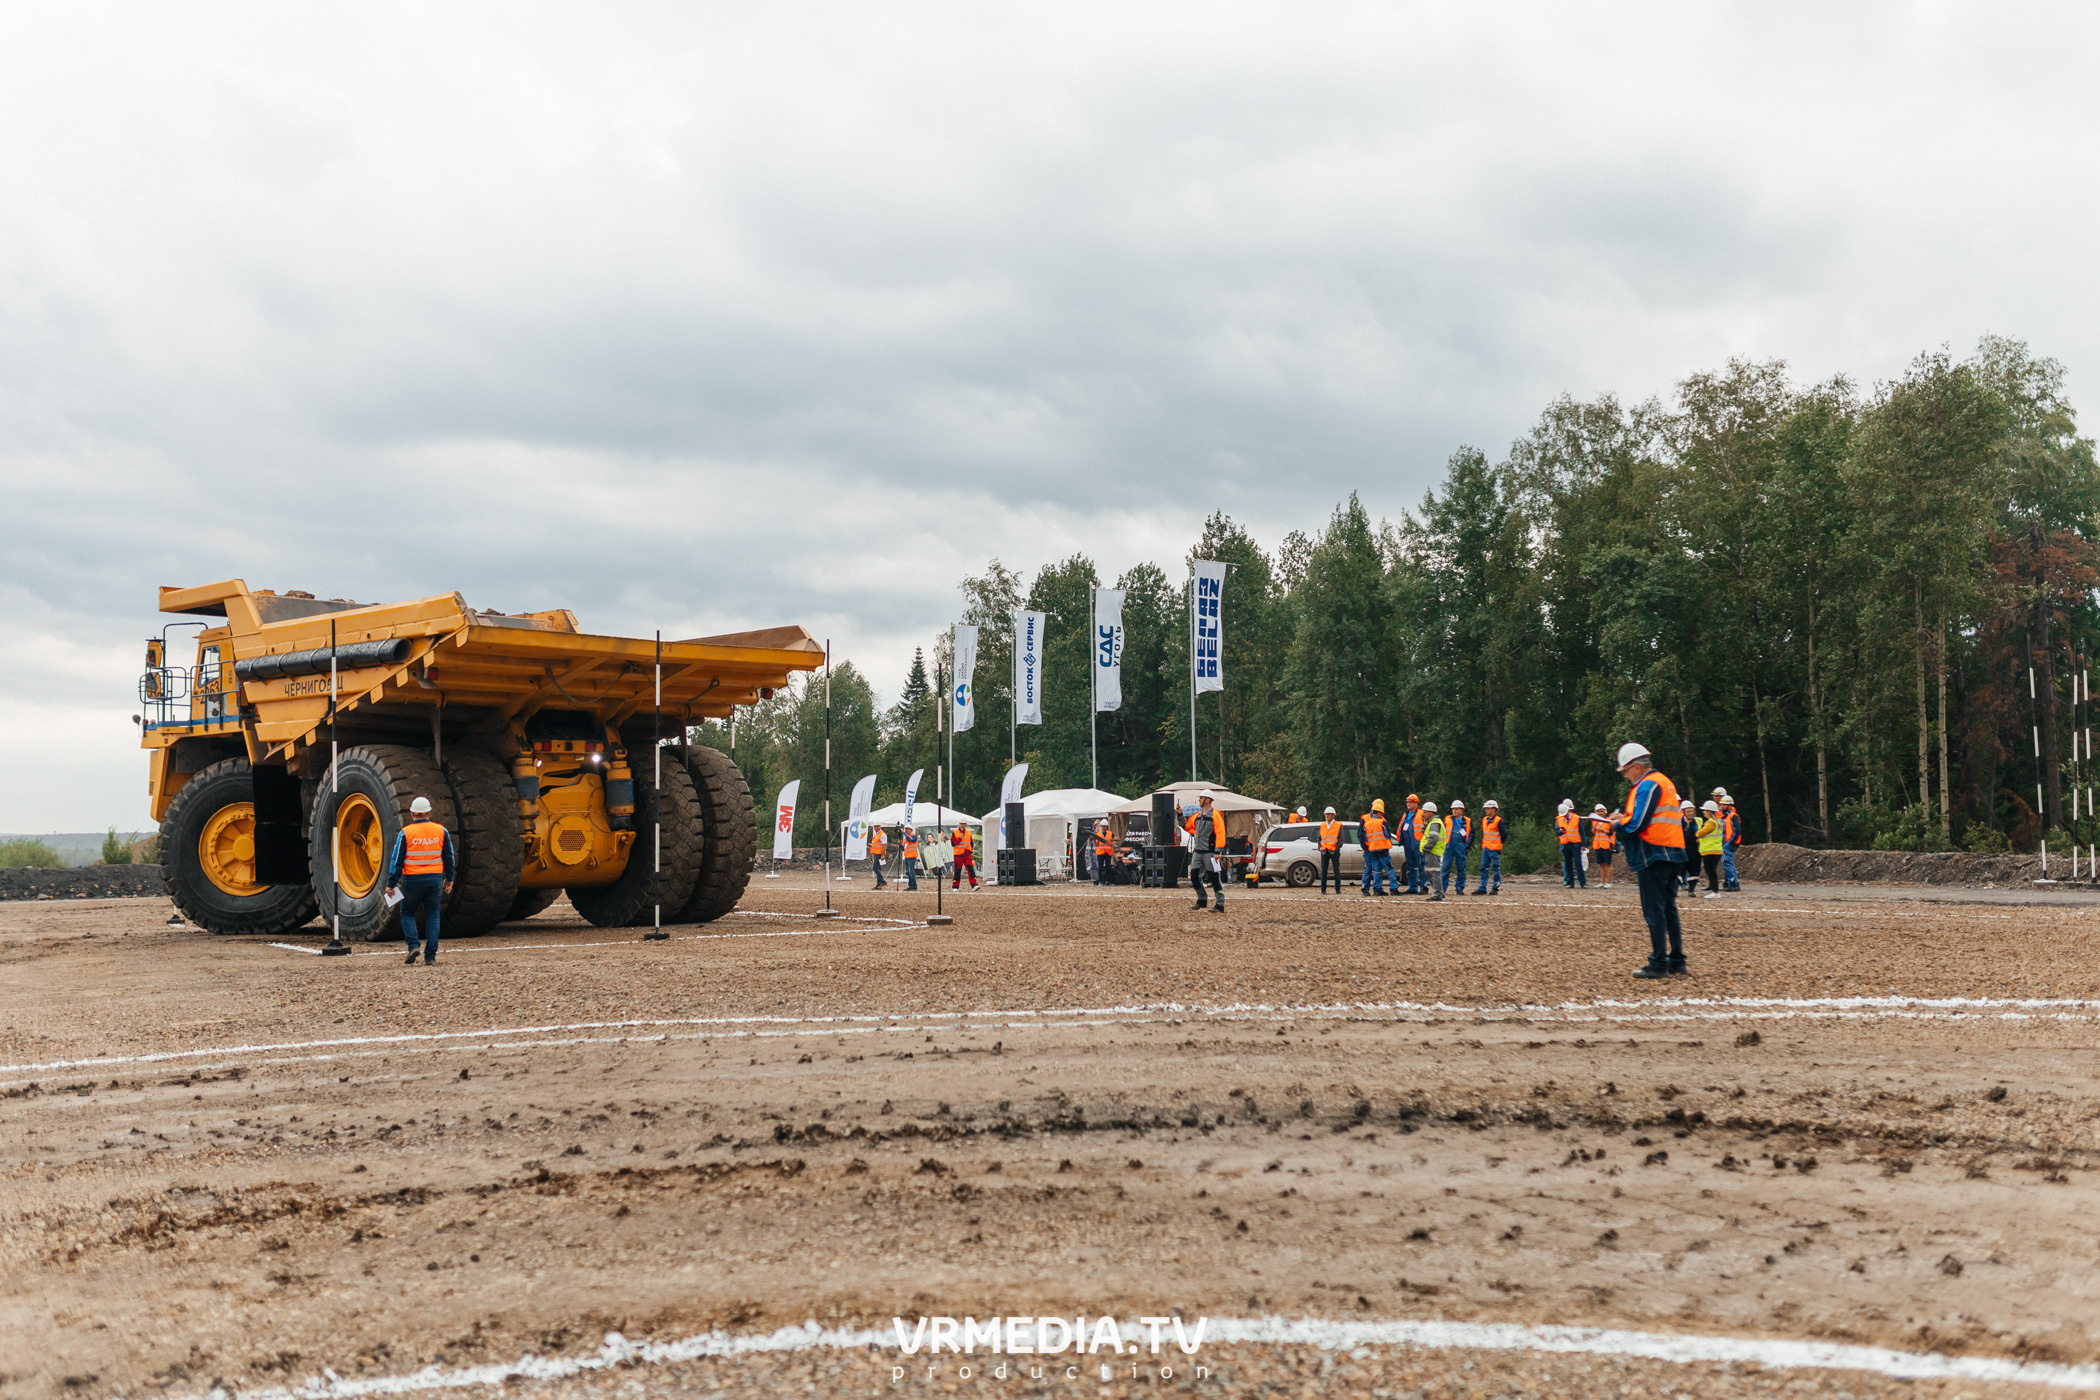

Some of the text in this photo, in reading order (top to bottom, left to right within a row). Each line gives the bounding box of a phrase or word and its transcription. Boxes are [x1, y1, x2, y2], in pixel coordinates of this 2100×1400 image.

[1197, 577, 1209, 677] БЕЛАЗ
[1207, 578, 1220, 677] BELAZ
[1099, 625, 1113, 667] СДС
[1113, 626, 1122, 667] УГОЛЬ
[284, 675, 344, 697] ЧЕРНИГОВЦ
[778, 805, 793, 833] 3M
[907, 790, 915, 823] nsell
[411, 837, 439, 846] СУДЬЯ
